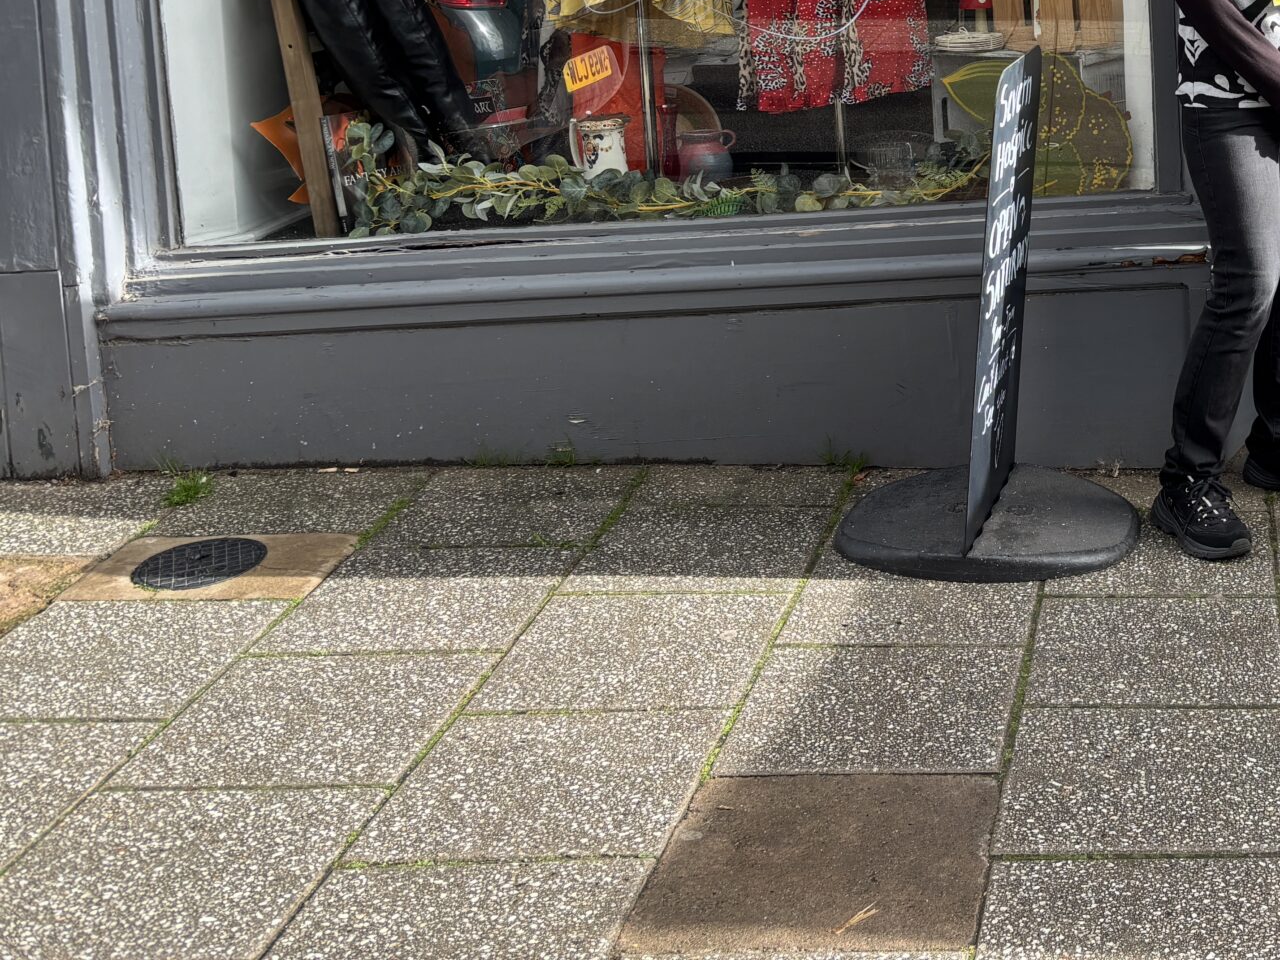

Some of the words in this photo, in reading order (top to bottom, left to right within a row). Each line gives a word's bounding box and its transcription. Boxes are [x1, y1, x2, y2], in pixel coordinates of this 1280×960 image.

[1000, 75, 1033, 128] Severn
[989, 196, 1020, 259] OPEN
[986, 230, 1031, 320] SATURDAY
